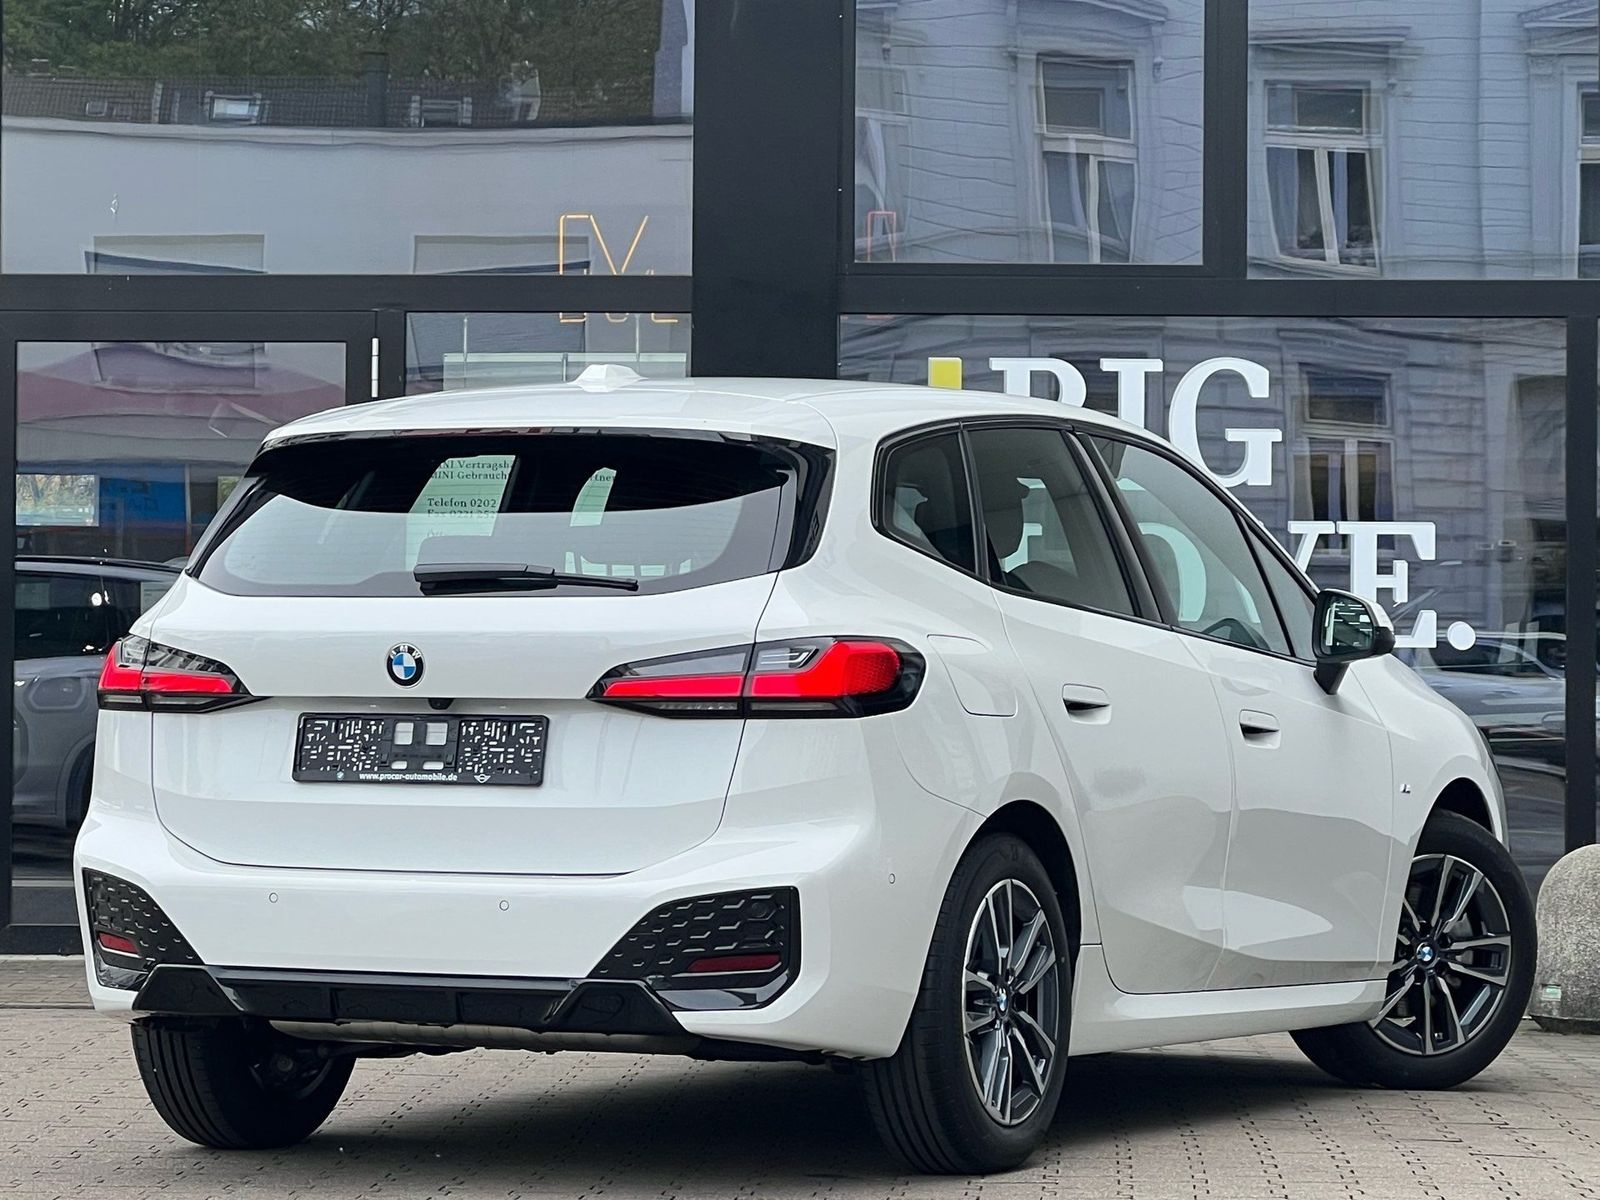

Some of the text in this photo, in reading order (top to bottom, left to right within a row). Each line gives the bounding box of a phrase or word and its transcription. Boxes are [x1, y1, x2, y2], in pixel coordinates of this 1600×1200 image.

[457, 460, 512, 472] Vertragsh
[427, 497, 497, 508] Telefon 0202
[359, 772, 458, 782] www.procar-automobile.de
